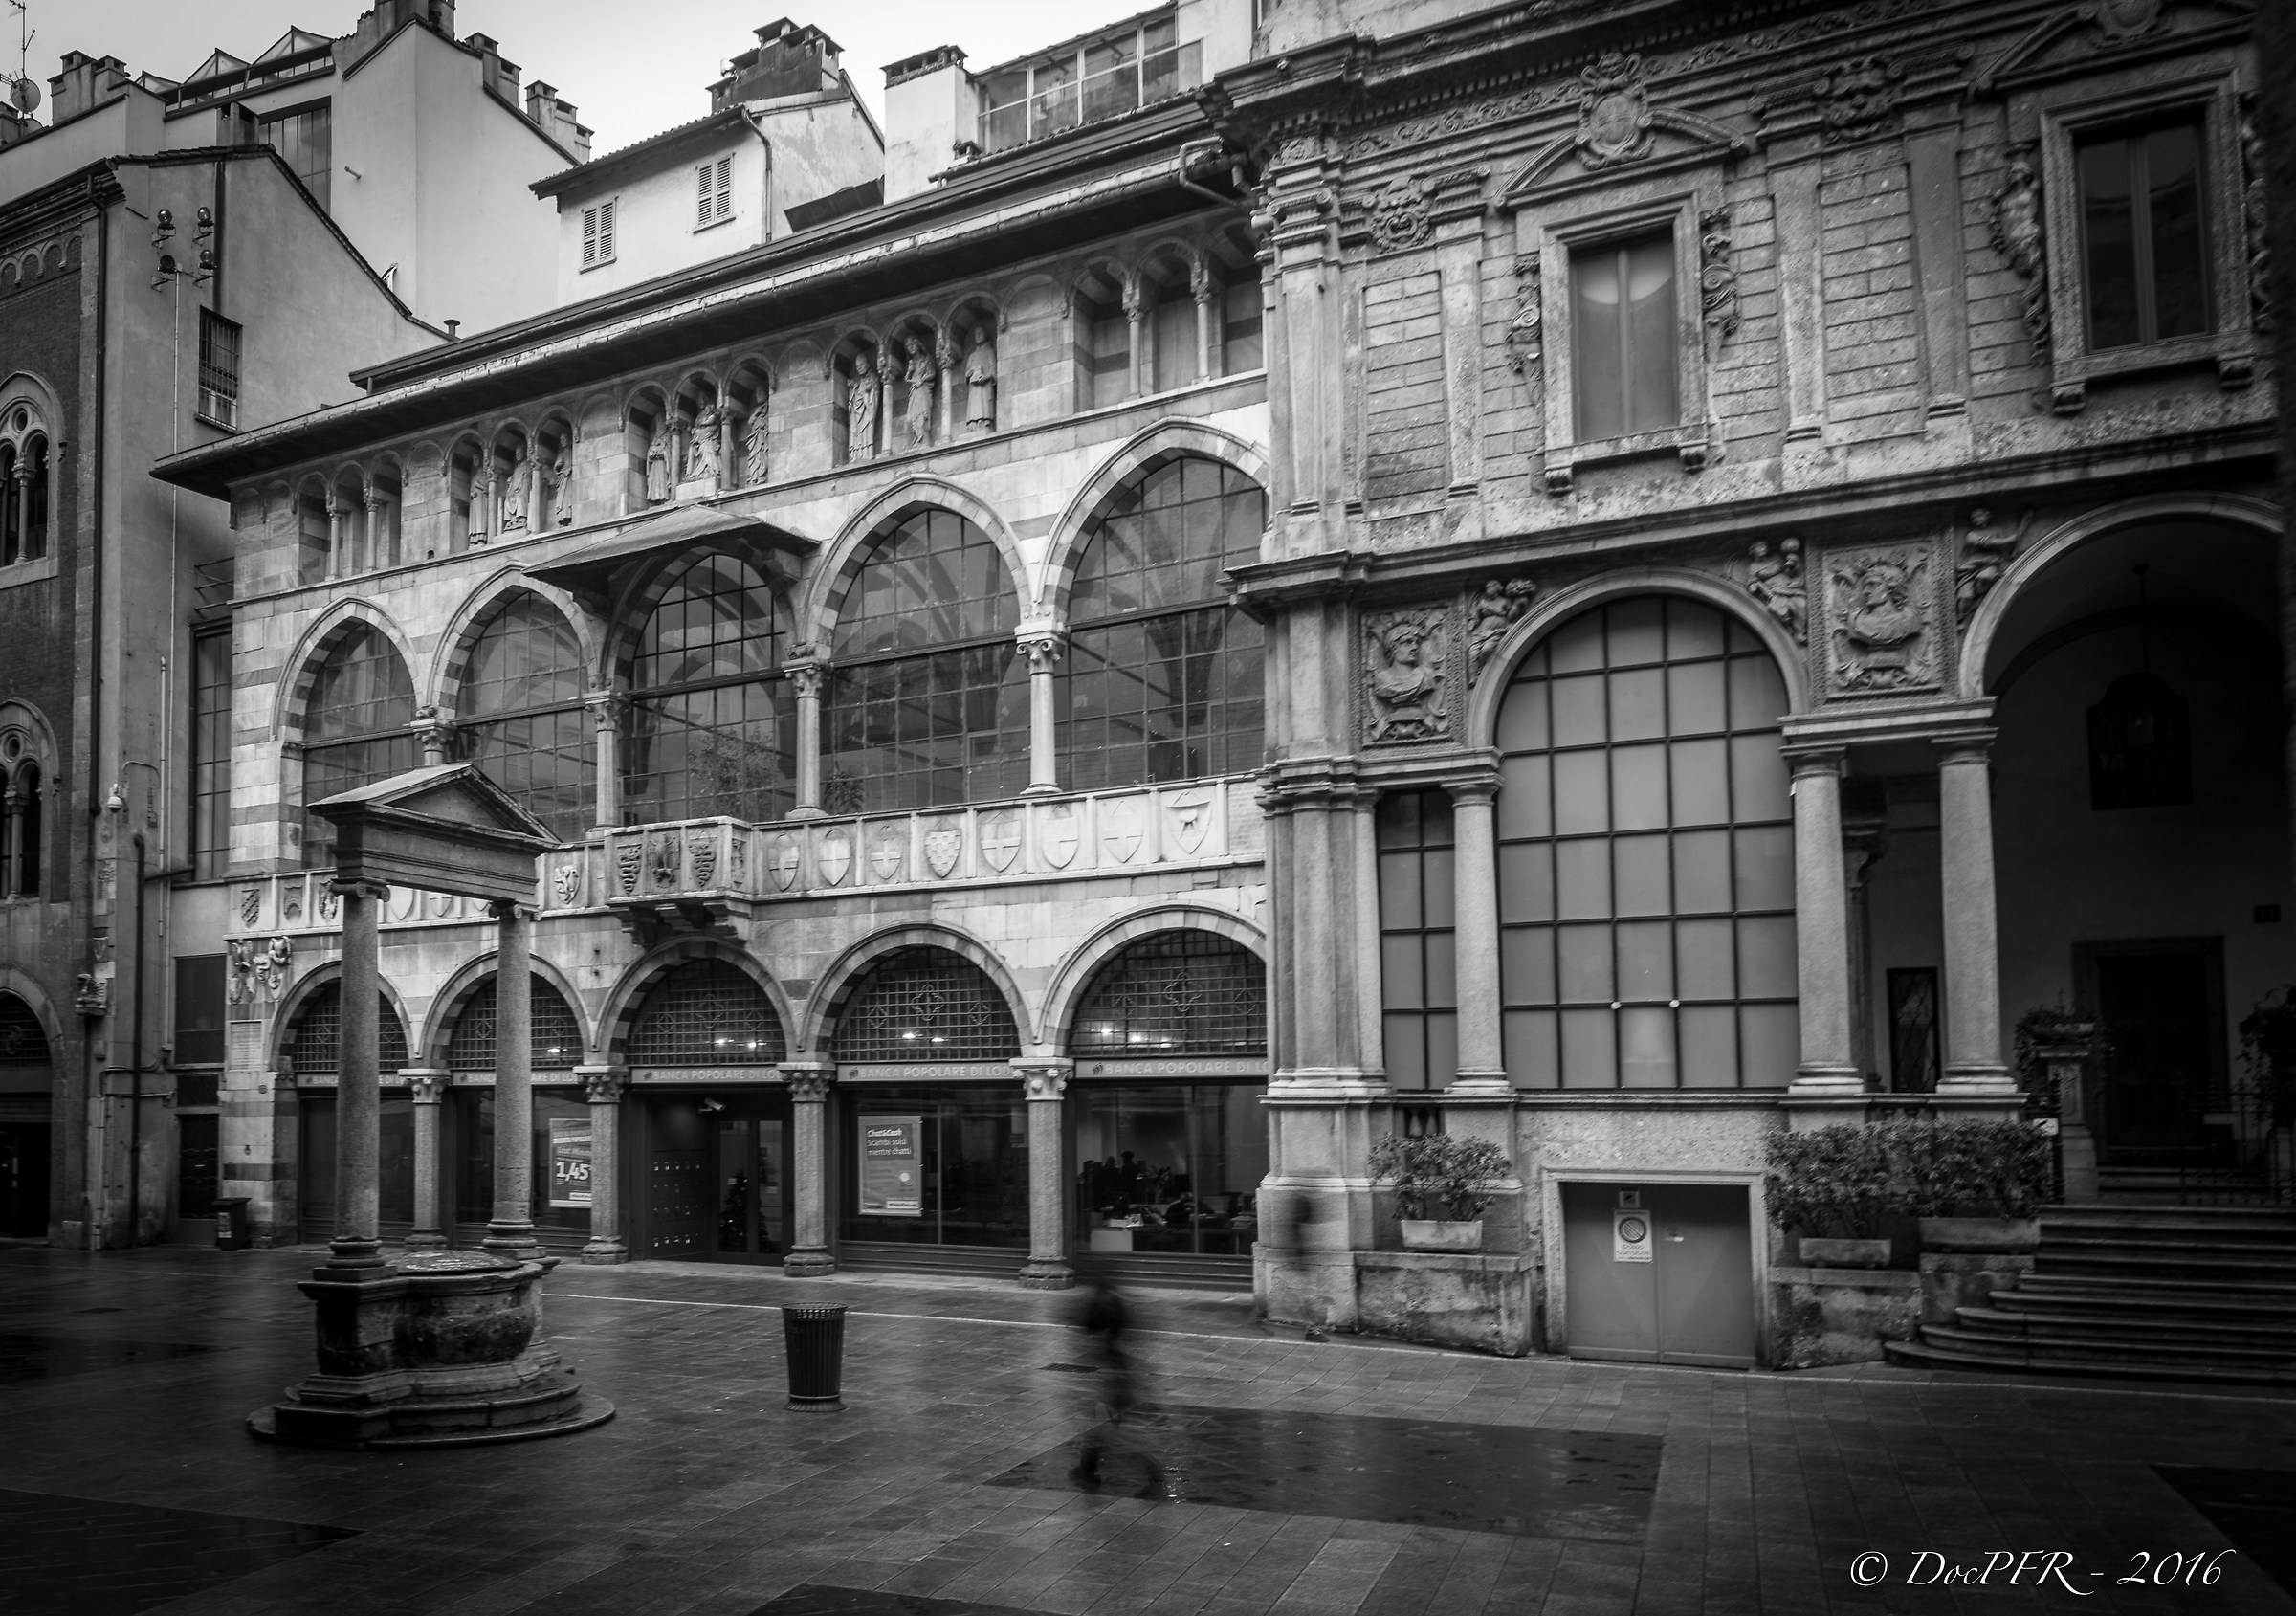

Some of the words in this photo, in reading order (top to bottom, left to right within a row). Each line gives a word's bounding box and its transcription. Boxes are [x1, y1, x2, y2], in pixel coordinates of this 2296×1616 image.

[860, 1067, 900, 1078] BANCA
[904, 1067, 966, 1077] POPOLARE
[970, 1066, 982, 1076] DI
[986, 1066, 1011, 1076] LOD
[1105, 1062, 1151, 1074] BANCA
[1158, 1061, 1231, 1074] POPOLARE
[1236, 1061, 1250, 1073] DI
[549, 1072, 561, 1082] DI
[653, 1070, 688, 1080] BANCA
[692, 1070, 745, 1080] POPOLARE
[748, 1069, 760, 1079] DI
